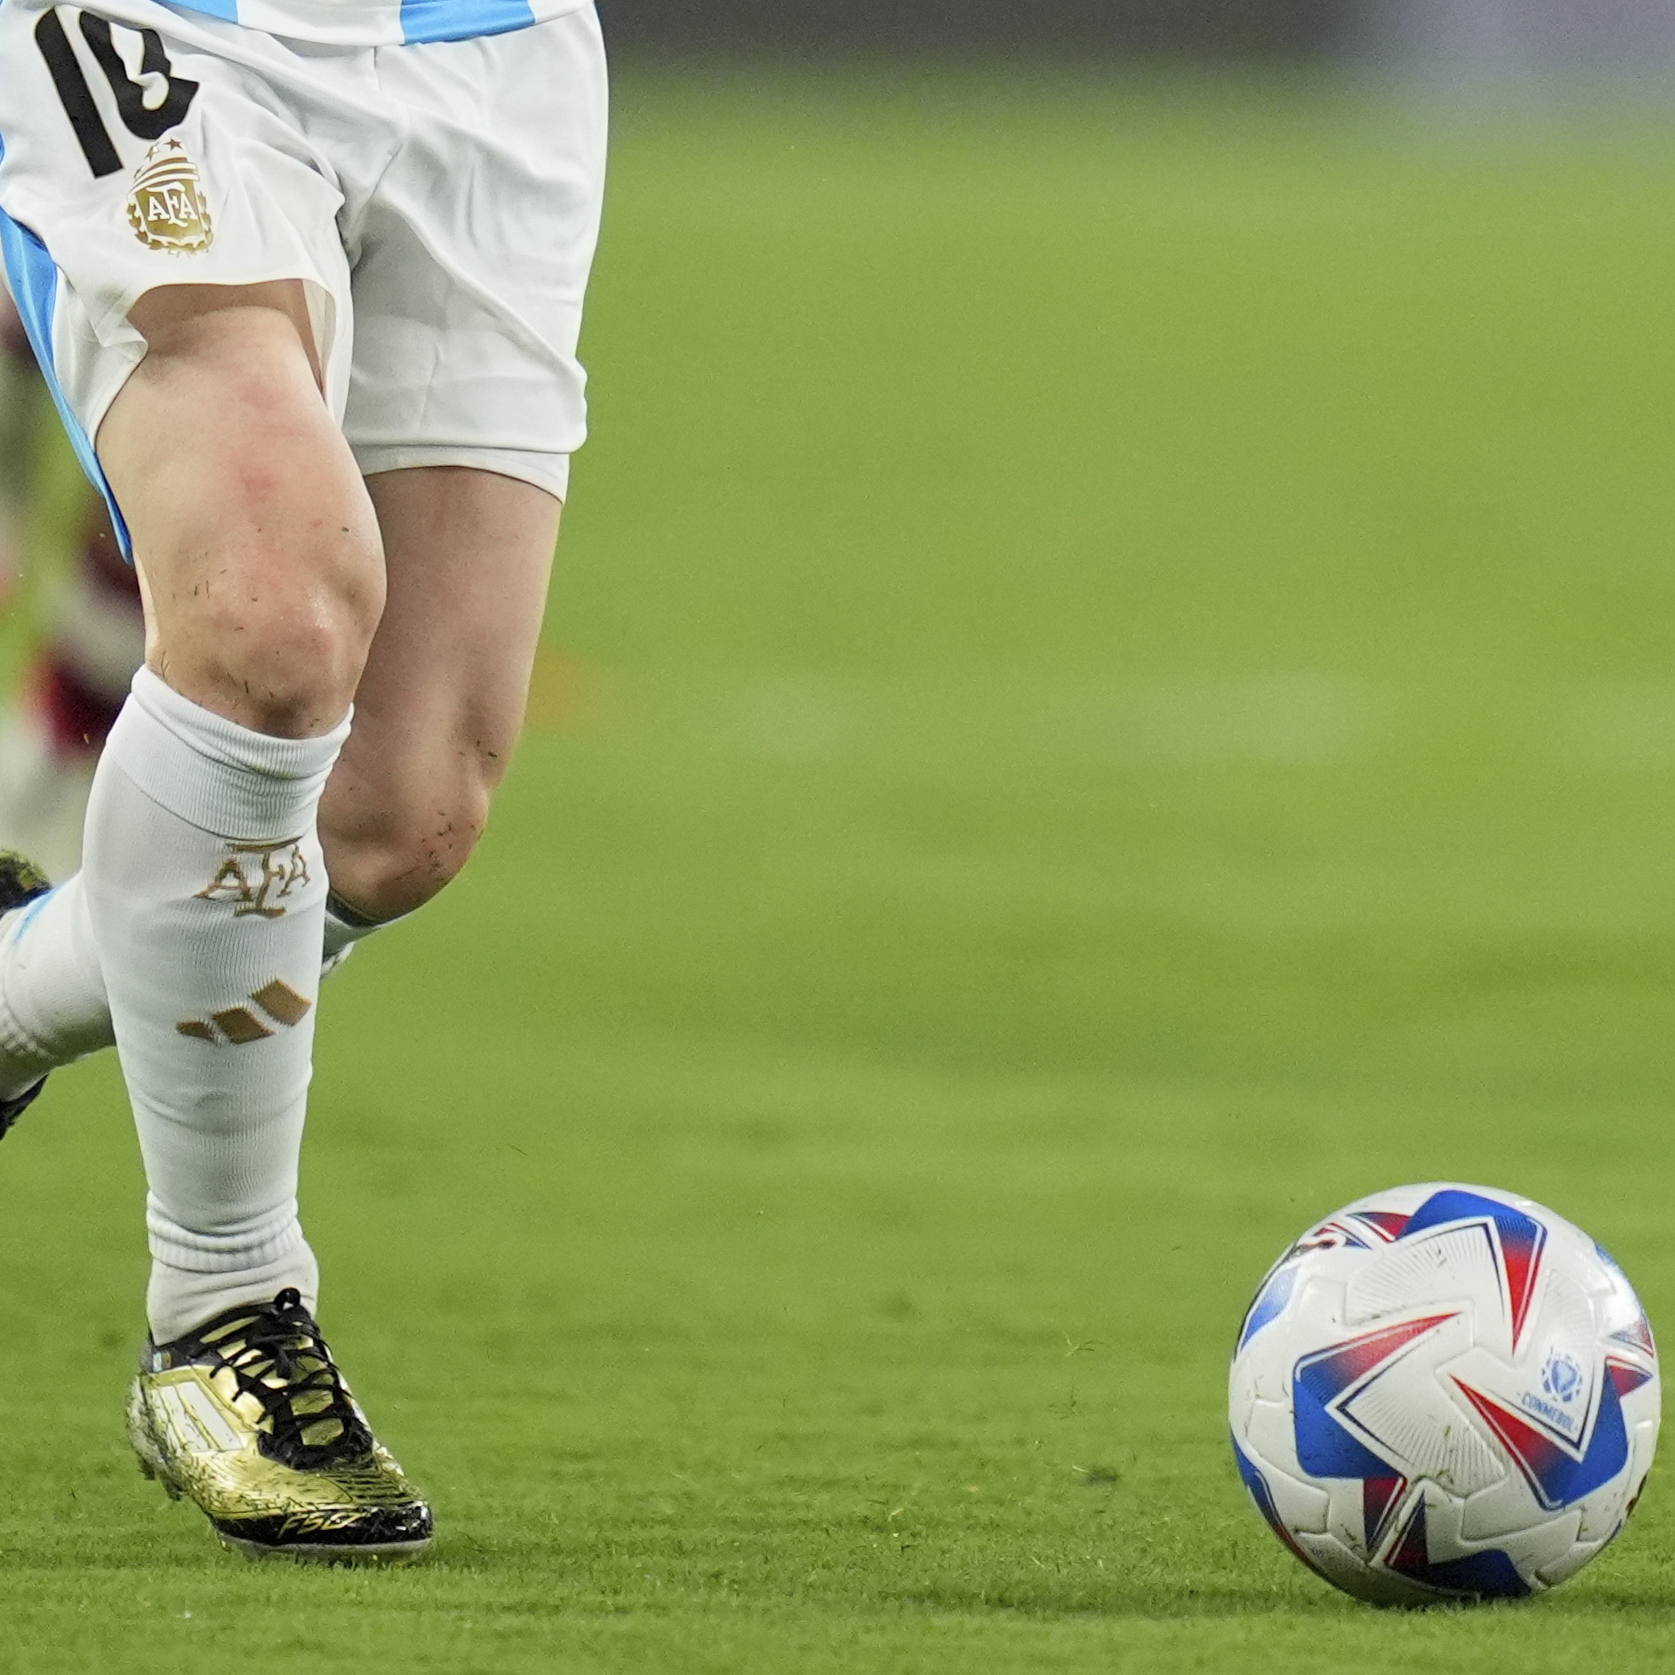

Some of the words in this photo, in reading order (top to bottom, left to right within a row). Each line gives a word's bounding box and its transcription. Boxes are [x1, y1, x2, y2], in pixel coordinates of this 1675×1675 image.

[35, 7, 200, 180] 10
[147, 181, 198, 228] AFA
[192, 836, 310, 918] AFA
